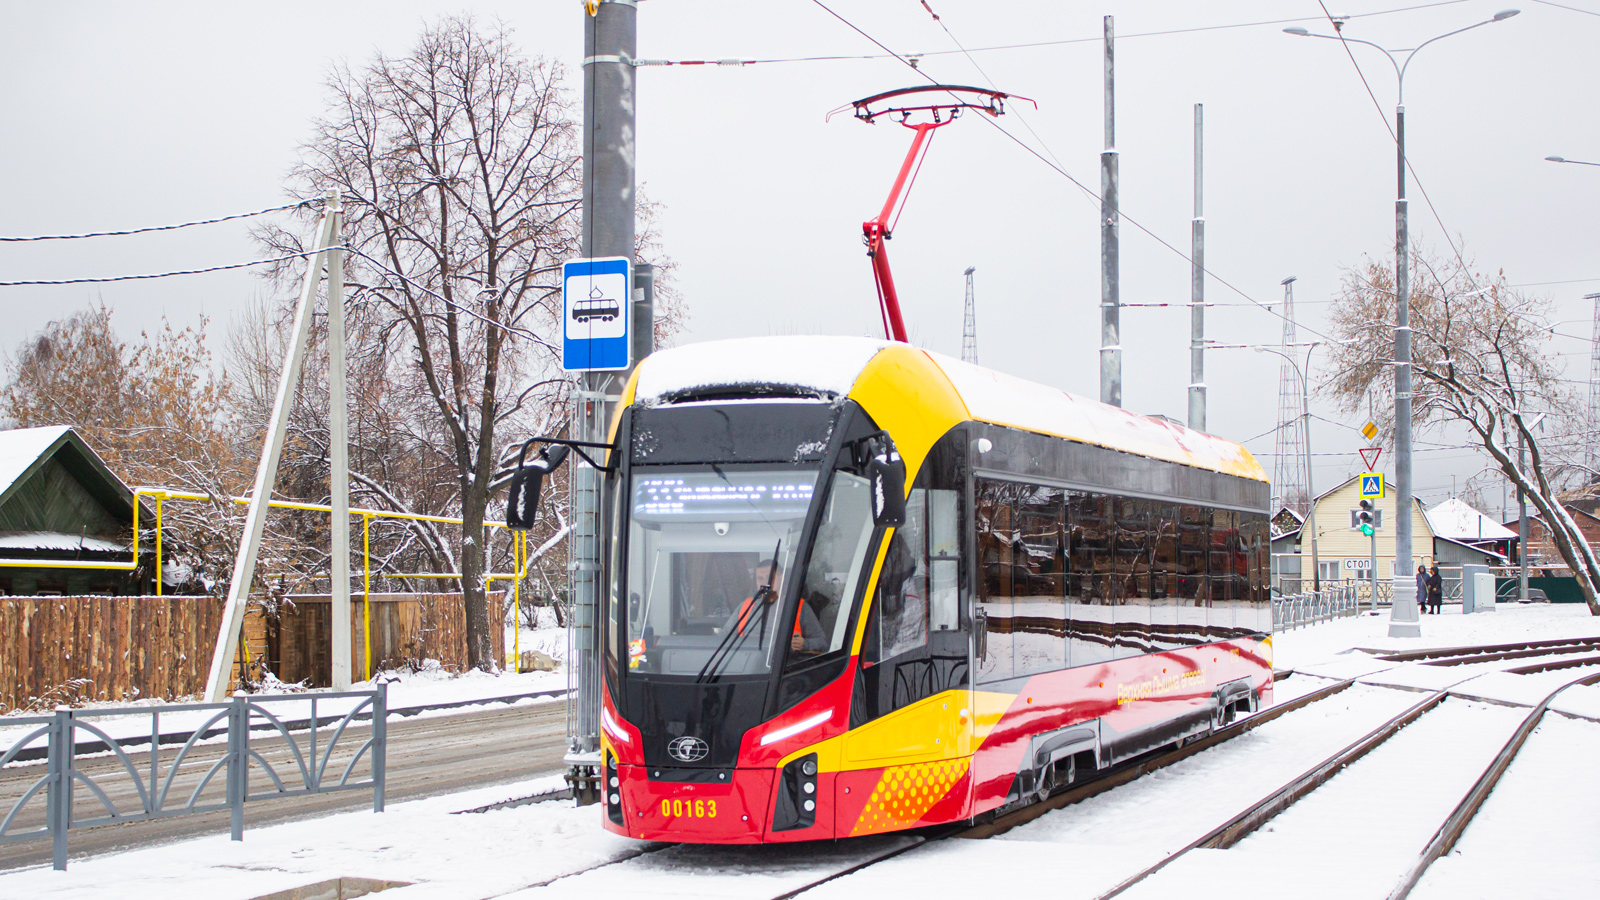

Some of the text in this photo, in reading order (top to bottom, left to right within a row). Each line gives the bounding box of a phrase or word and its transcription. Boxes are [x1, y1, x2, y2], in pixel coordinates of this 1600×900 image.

[1346, 560, 1370, 569] СТОП
[1117, 681, 1152, 709] Верхняя
[661, 798, 717, 818] 00163
